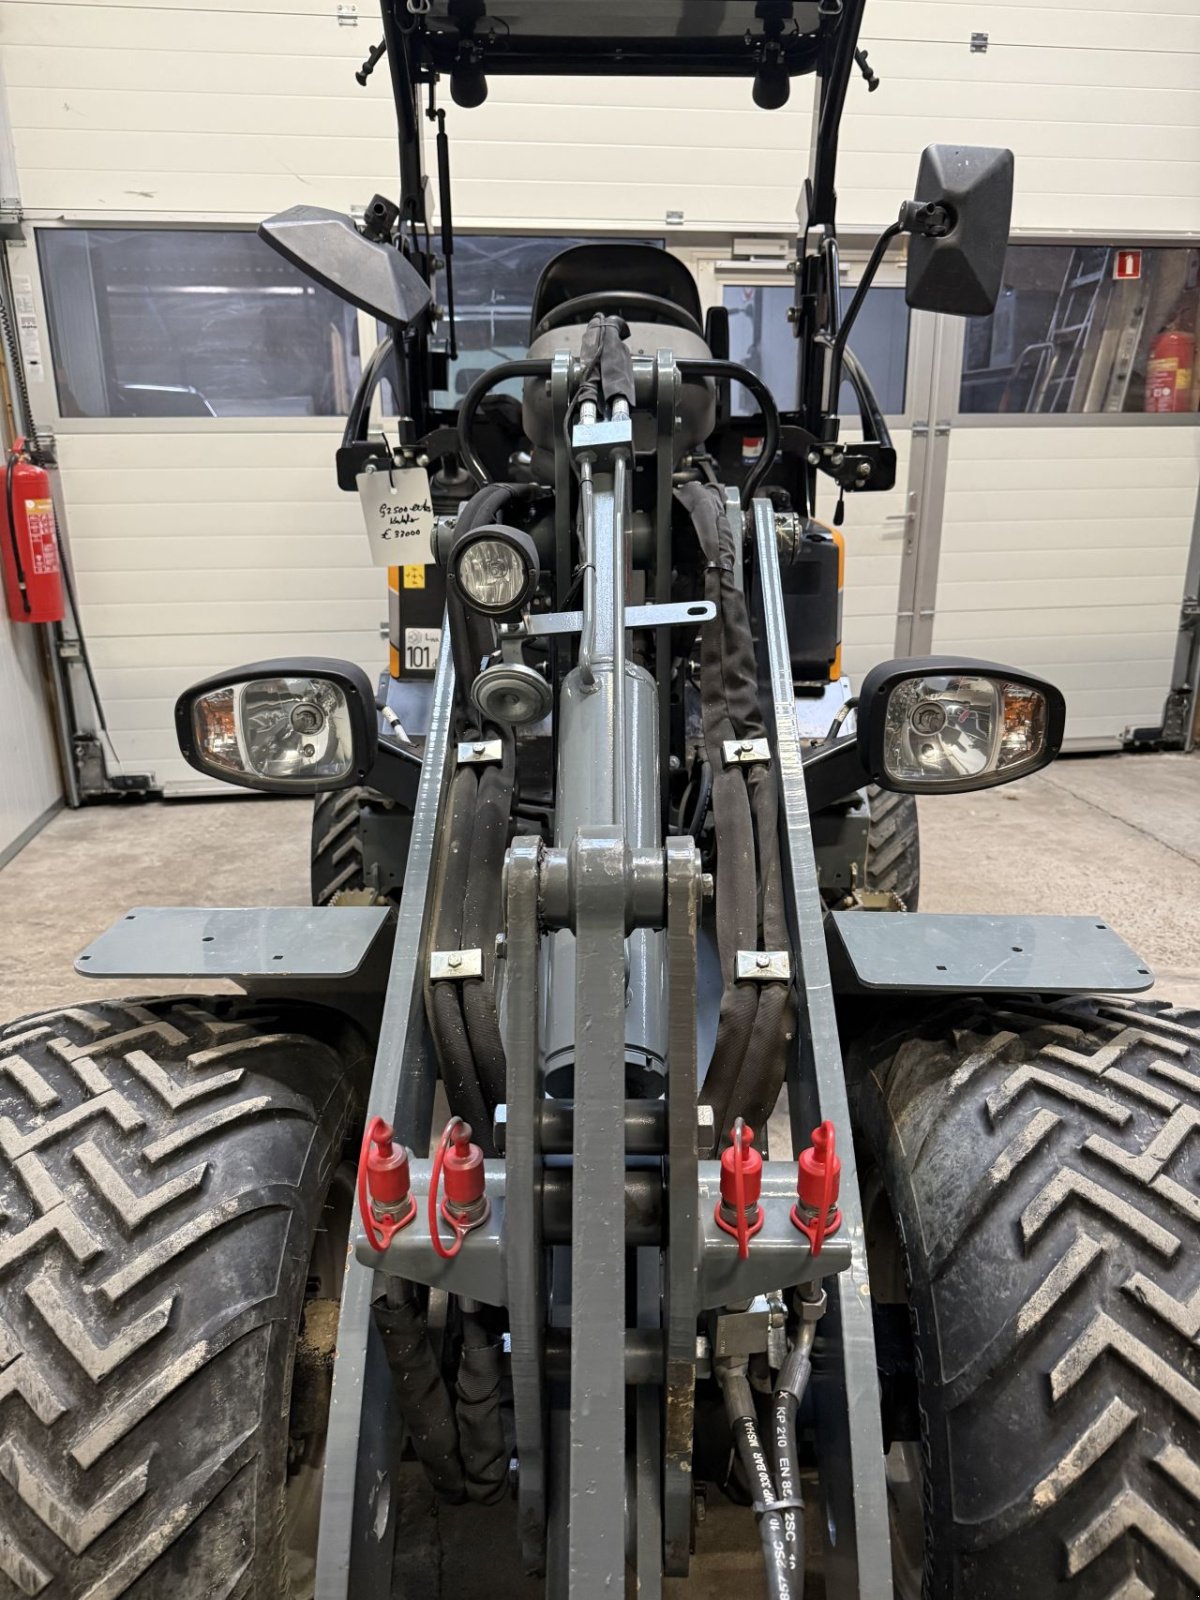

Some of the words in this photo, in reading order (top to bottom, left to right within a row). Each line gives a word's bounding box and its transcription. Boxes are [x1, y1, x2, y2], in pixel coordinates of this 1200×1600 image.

[407, 645, 430, 668] 101
[776, 1406, 787, 1424] KP
[744, 1421, 760, 1448] MSHA
[776, 1427, 788, 1448] 210
[752, 1452, 767, 1473] BAR
[779, 1457, 791, 1477] EN
[758, 1472, 771, 1488] 330
[784, 1512, 796, 1542] 2SC
